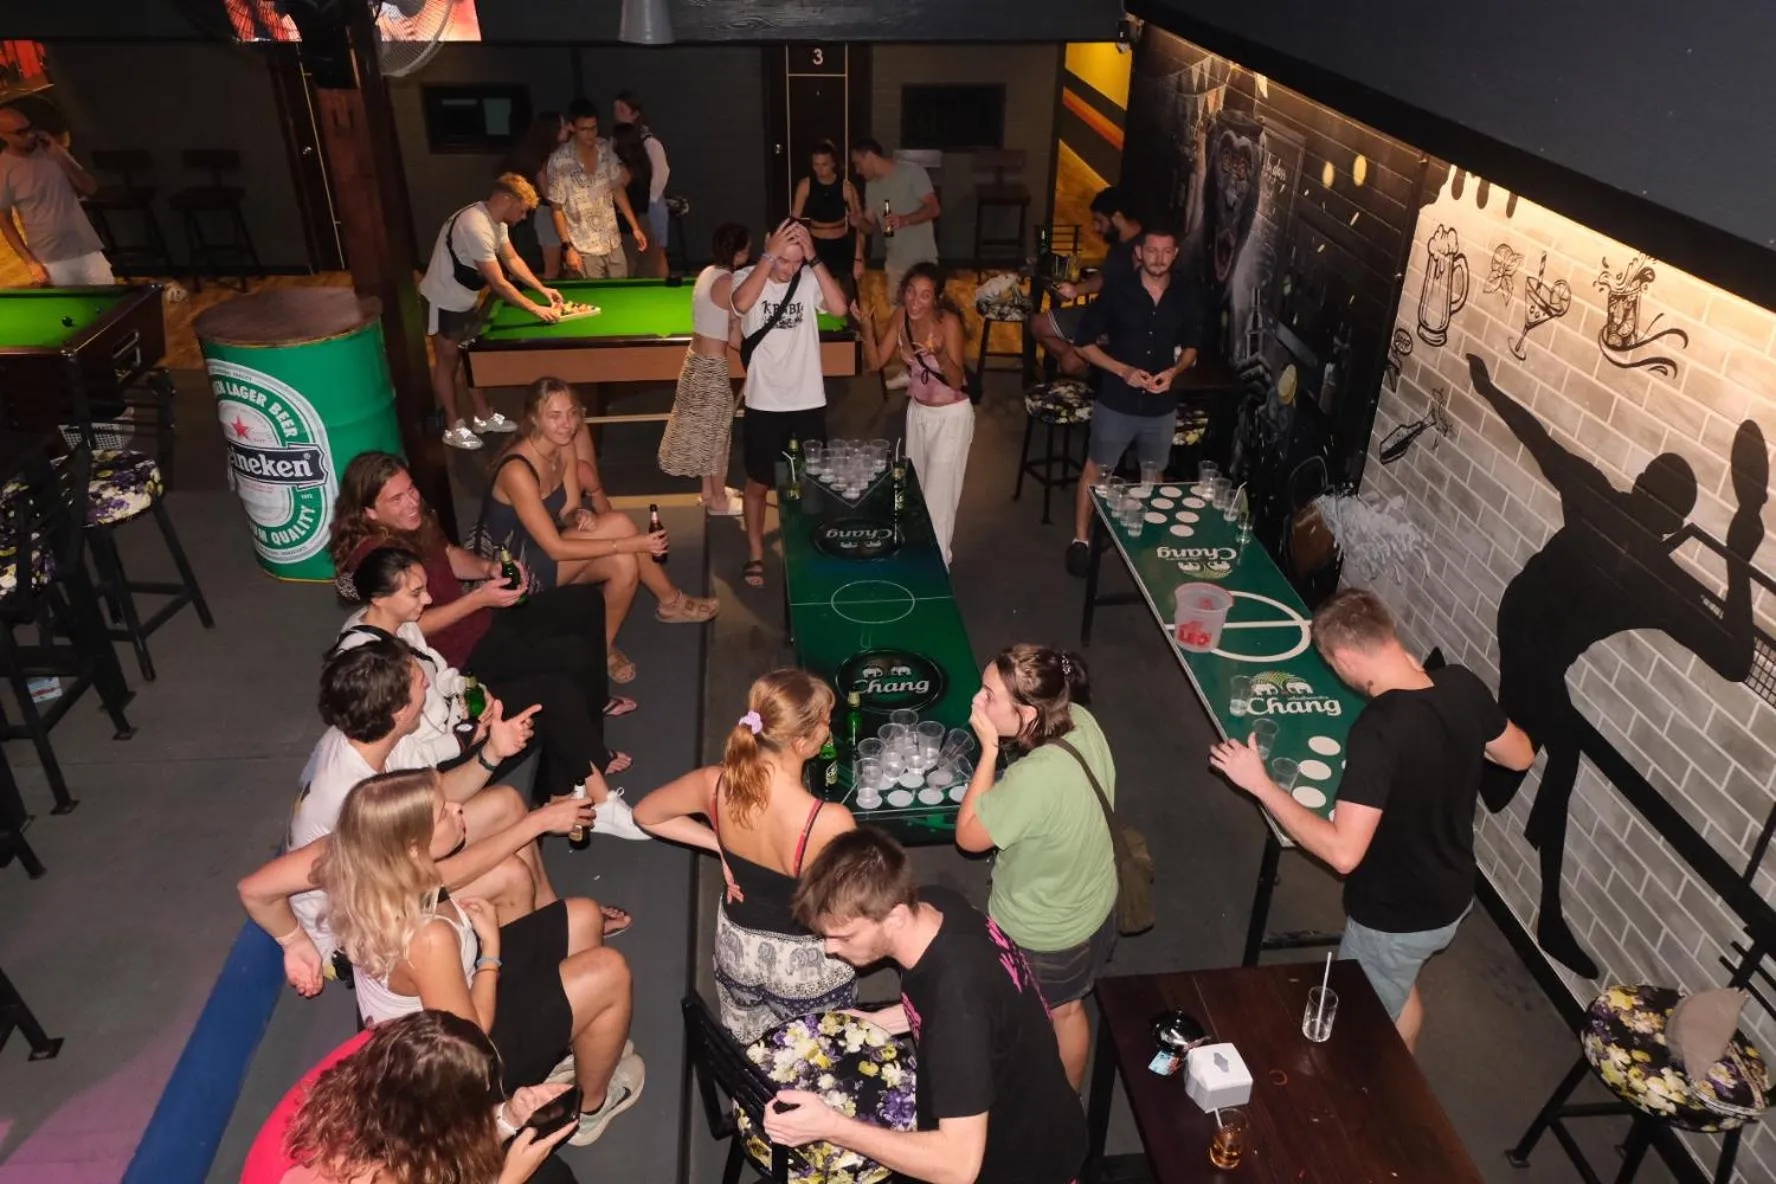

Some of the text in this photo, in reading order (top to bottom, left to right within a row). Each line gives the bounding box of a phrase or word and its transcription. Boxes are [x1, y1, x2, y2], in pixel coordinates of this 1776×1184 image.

[812, 48, 824, 65] 3
[226, 382, 267, 407] LAGER
[268, 401, 298, 438] BEER
[270, 505, 315, 545] QUALITY
[825, 528, 893, 539] Chang
[1156, 546, 1237, 560] Chang
[1247, 697, 1341, 717] Chang
